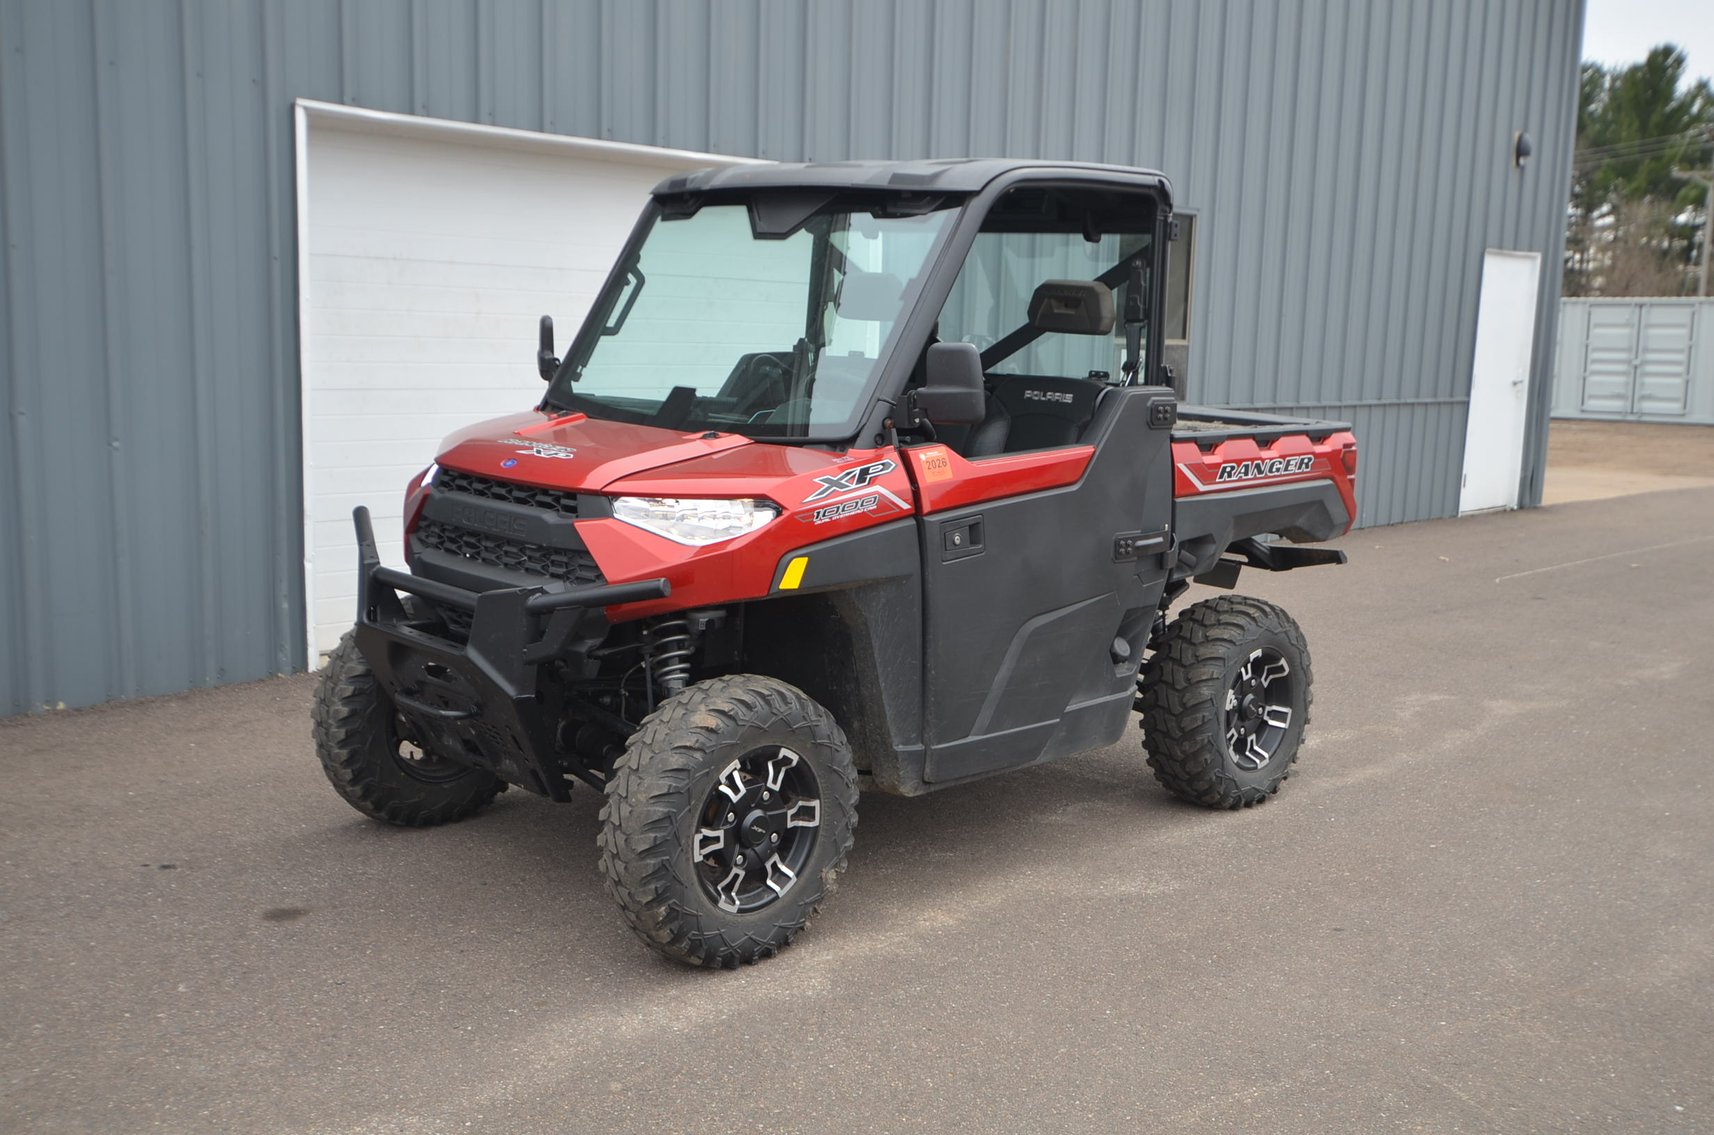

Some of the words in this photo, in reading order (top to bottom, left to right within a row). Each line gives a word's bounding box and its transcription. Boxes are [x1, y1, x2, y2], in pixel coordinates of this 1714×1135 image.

[1024, 390, 1073, 403] POLARIS
[926, 457, 948, 470] 2026
[1216, 455, 1314, 482] RANGER
[801, 459, 896, 503] XP
[813, 494, 879, 521] 1000
